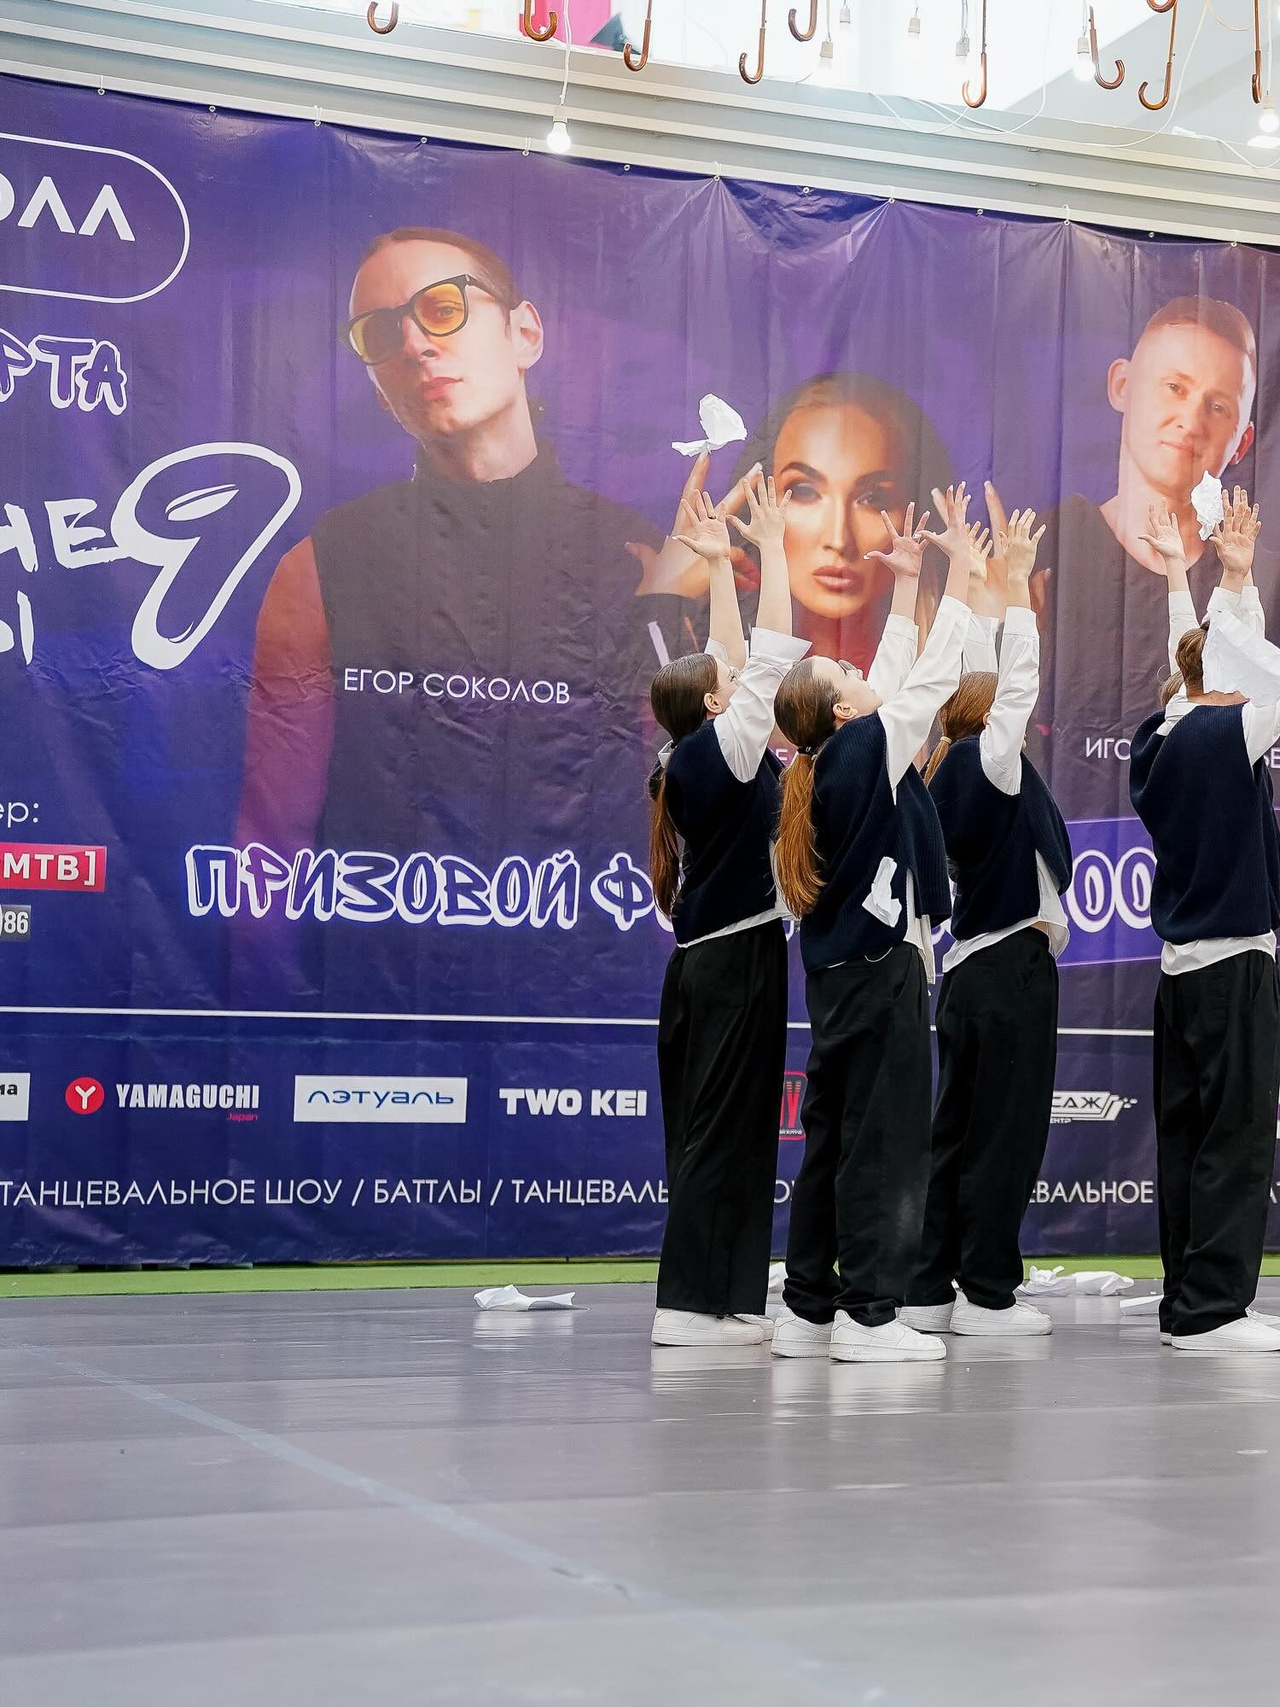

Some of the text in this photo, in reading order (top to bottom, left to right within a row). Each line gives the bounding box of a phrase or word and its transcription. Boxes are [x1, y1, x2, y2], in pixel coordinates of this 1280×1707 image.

[0, 172, 136, 241] ЛЛ
[344, 667, 571, 705] ЕГОР СОКОЛОВ
[1085, 737, 1132, 761] ИГО
[185, 842, 580, 930] ПРИЗОВОЙ
[116, 1083, 260, 1109] YAMAGUCHI
[499, 1088, 647, 1116] TWO KEI
[226, 1112, 259, 1122] Japan
[0, 1179, 255, 1208] ТАНЦЕВАЛЬНОЕ
[266, 1179, 343, 1205] ШОУ
[374, 1179, 481, 1204] БАТТЛЫ
[511, 1179, 669, 1206] ТАНЦЕВАЛЬ
